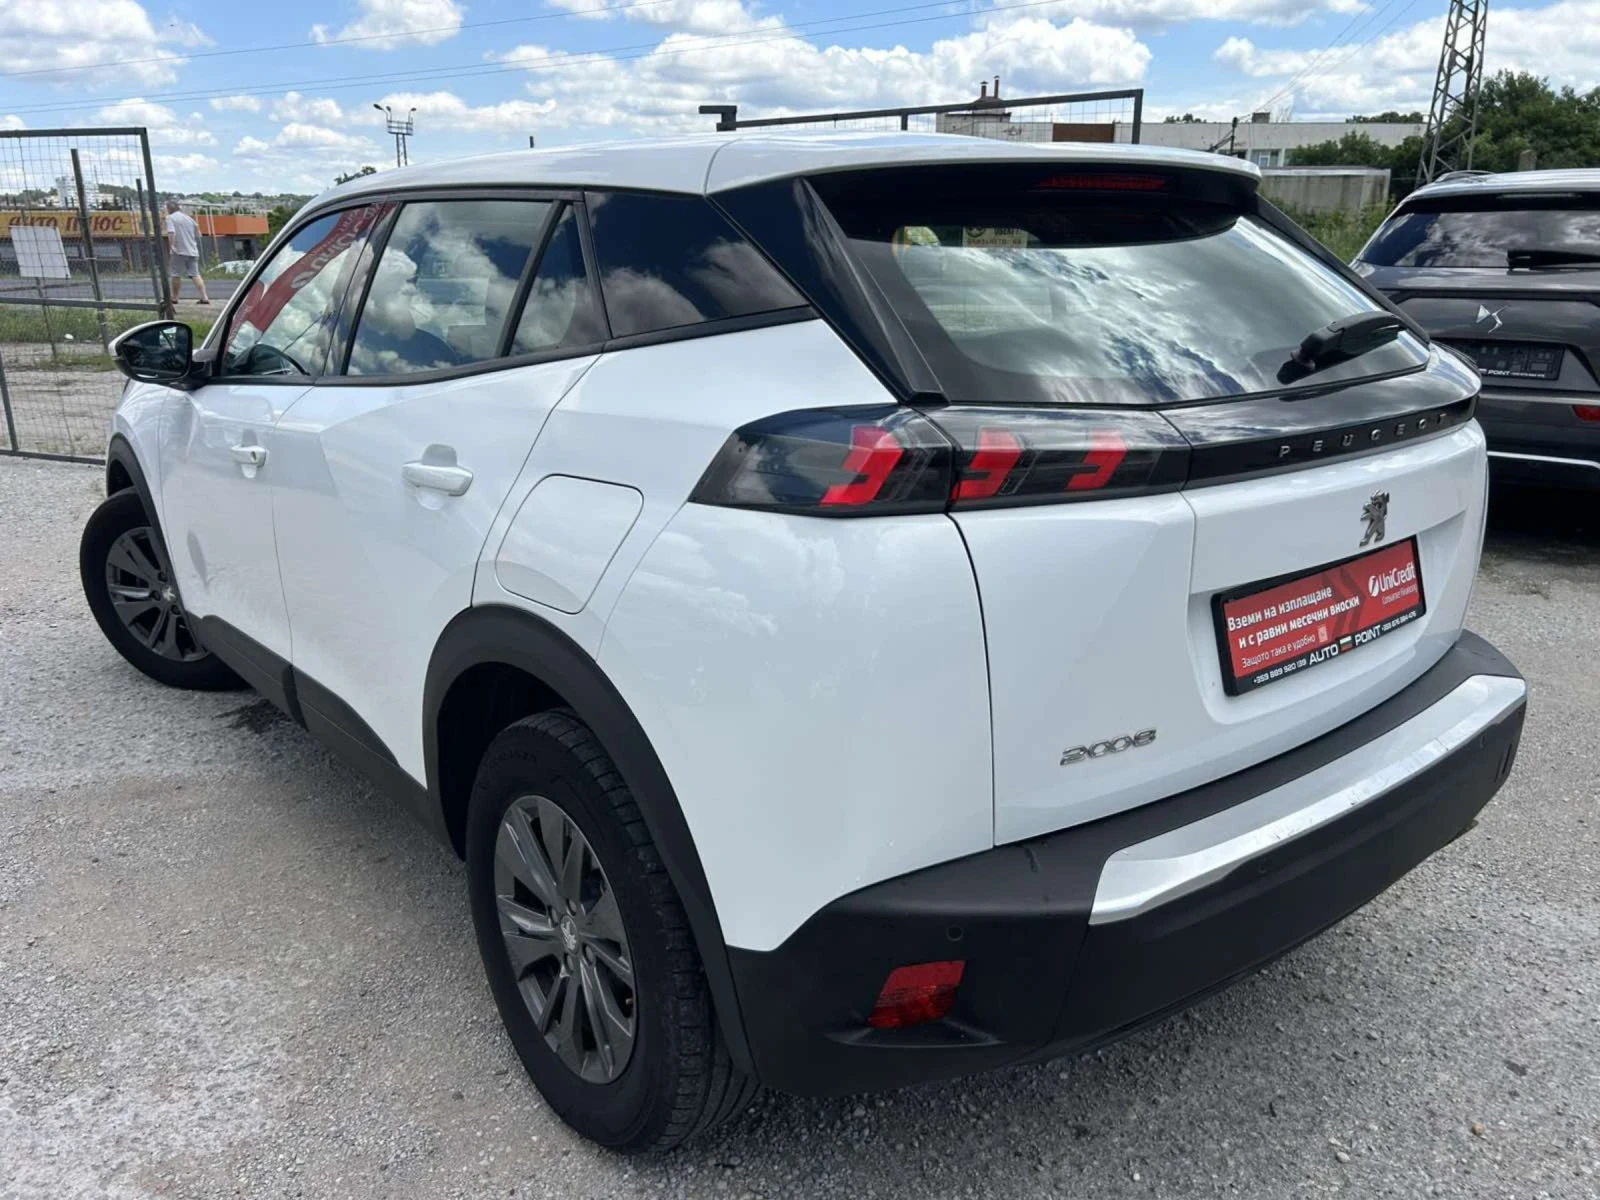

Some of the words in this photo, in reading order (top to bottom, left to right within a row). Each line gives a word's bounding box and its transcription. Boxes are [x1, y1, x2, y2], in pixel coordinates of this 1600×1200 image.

[1379, 562, 1416, 592] UniCredit
[1228, 611, 1262, 632] Вземи
[1264, 606, 1277, 619] на
[1279, 587, 1333, 613] изплащане
[1239, 636, 1247, 649] и
[1248, 634, 1255, 646] с
[1256, 622, 1288, 646] равни
[1289, 610, 1329, 630] месечни
[1330, 595, 1360, 616] вноски
[1241, 651, 1270, 669] Защото
[1270, 645, 1287, 657] така
[1308, 643, 1339, 666] AUTO
[1354, 624, 1381, 646] POINT
